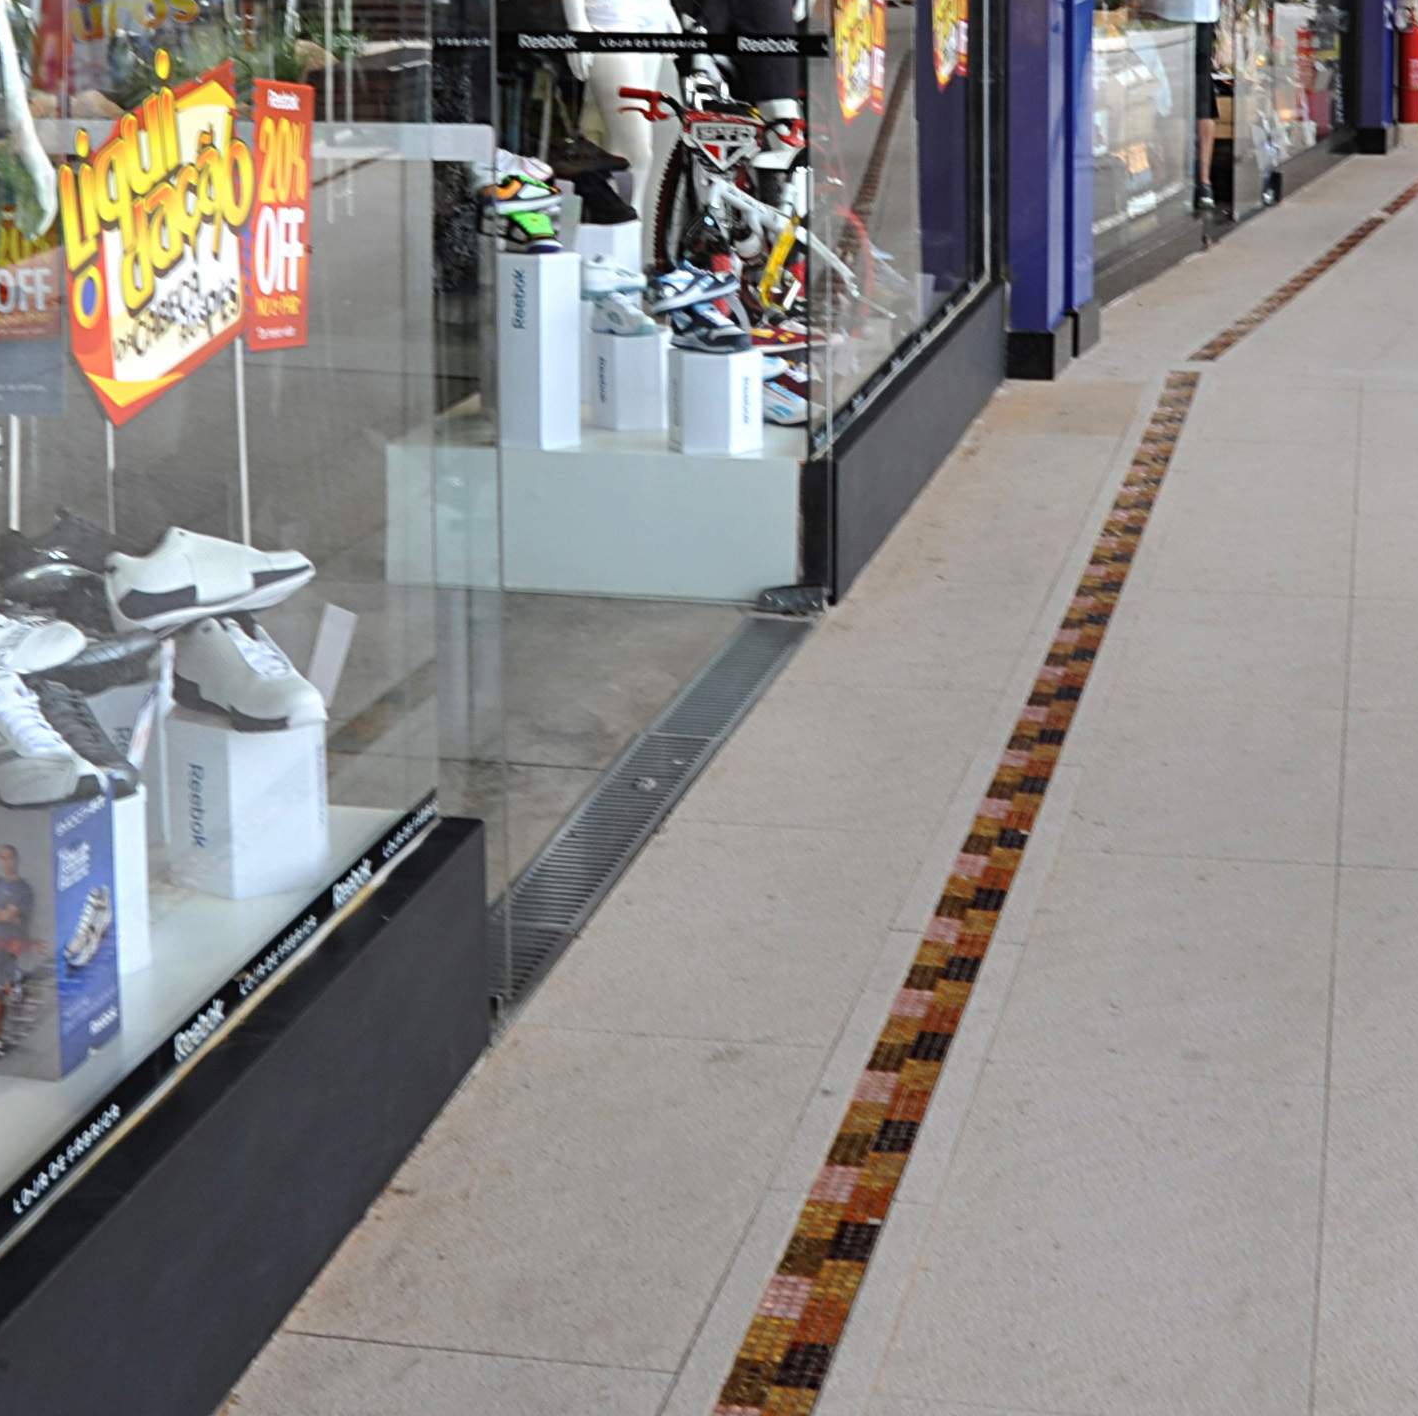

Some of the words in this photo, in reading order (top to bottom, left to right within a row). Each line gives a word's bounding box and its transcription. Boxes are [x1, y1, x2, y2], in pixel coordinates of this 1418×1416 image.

[518, 32, 579, 50] Reebok
[737, 35, 800, 53] Reebok
[59, 47, 181, 272] Liqui
[258, 116, 307, 204] 20%
[254, 205, 306, 296] OFF
[510, 268, 526, 330] Reebok
[187, 762, 209, 849] Reebok
[174, 998, 225, 1063] Reebok
